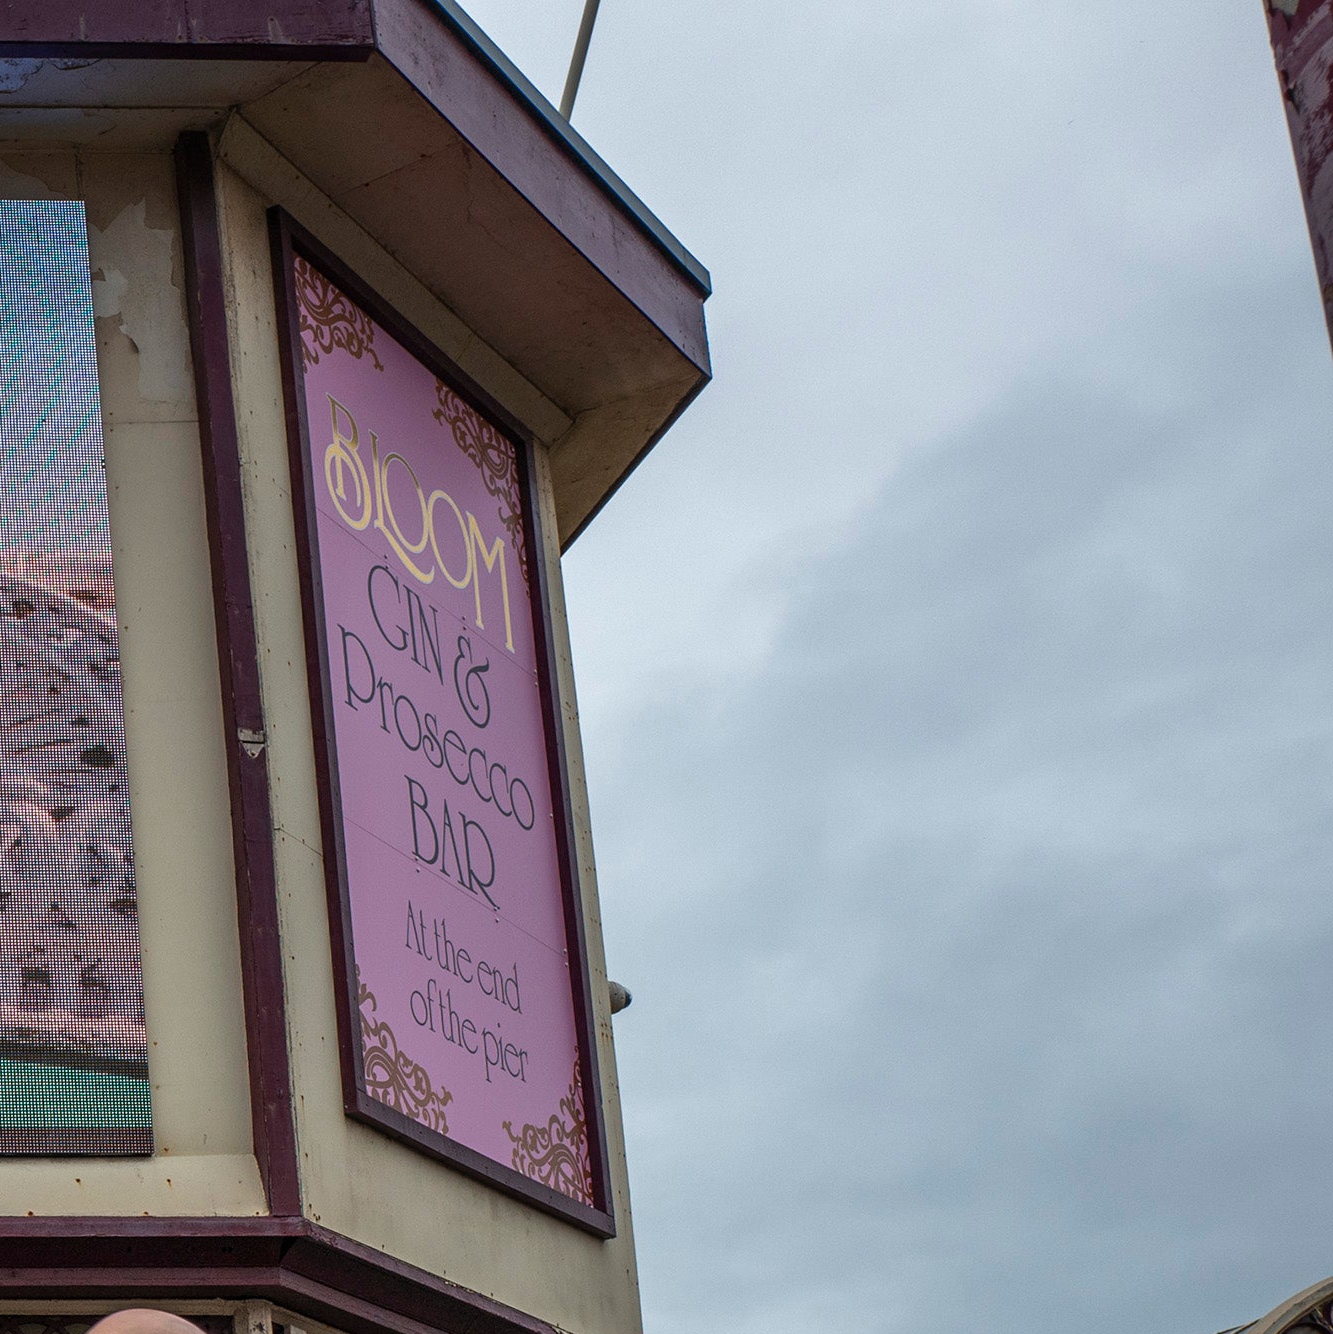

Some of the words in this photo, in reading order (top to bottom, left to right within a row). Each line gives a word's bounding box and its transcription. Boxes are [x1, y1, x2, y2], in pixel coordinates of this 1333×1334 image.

[324, 392, 515, 654] BLOOM
[367, 564, 445, 685] GIN
[454, 635, 491, 728] &
[404, 774, 500, 910] BAR
[405, 900, 432, 964] At
[434, 917, 474, 985] the
[476, 962, 523, 1015] end
[409, 979, 436, 1033] of
[436, 993, 479, 1056] the
[482, 1022, 530, 1084] pier
